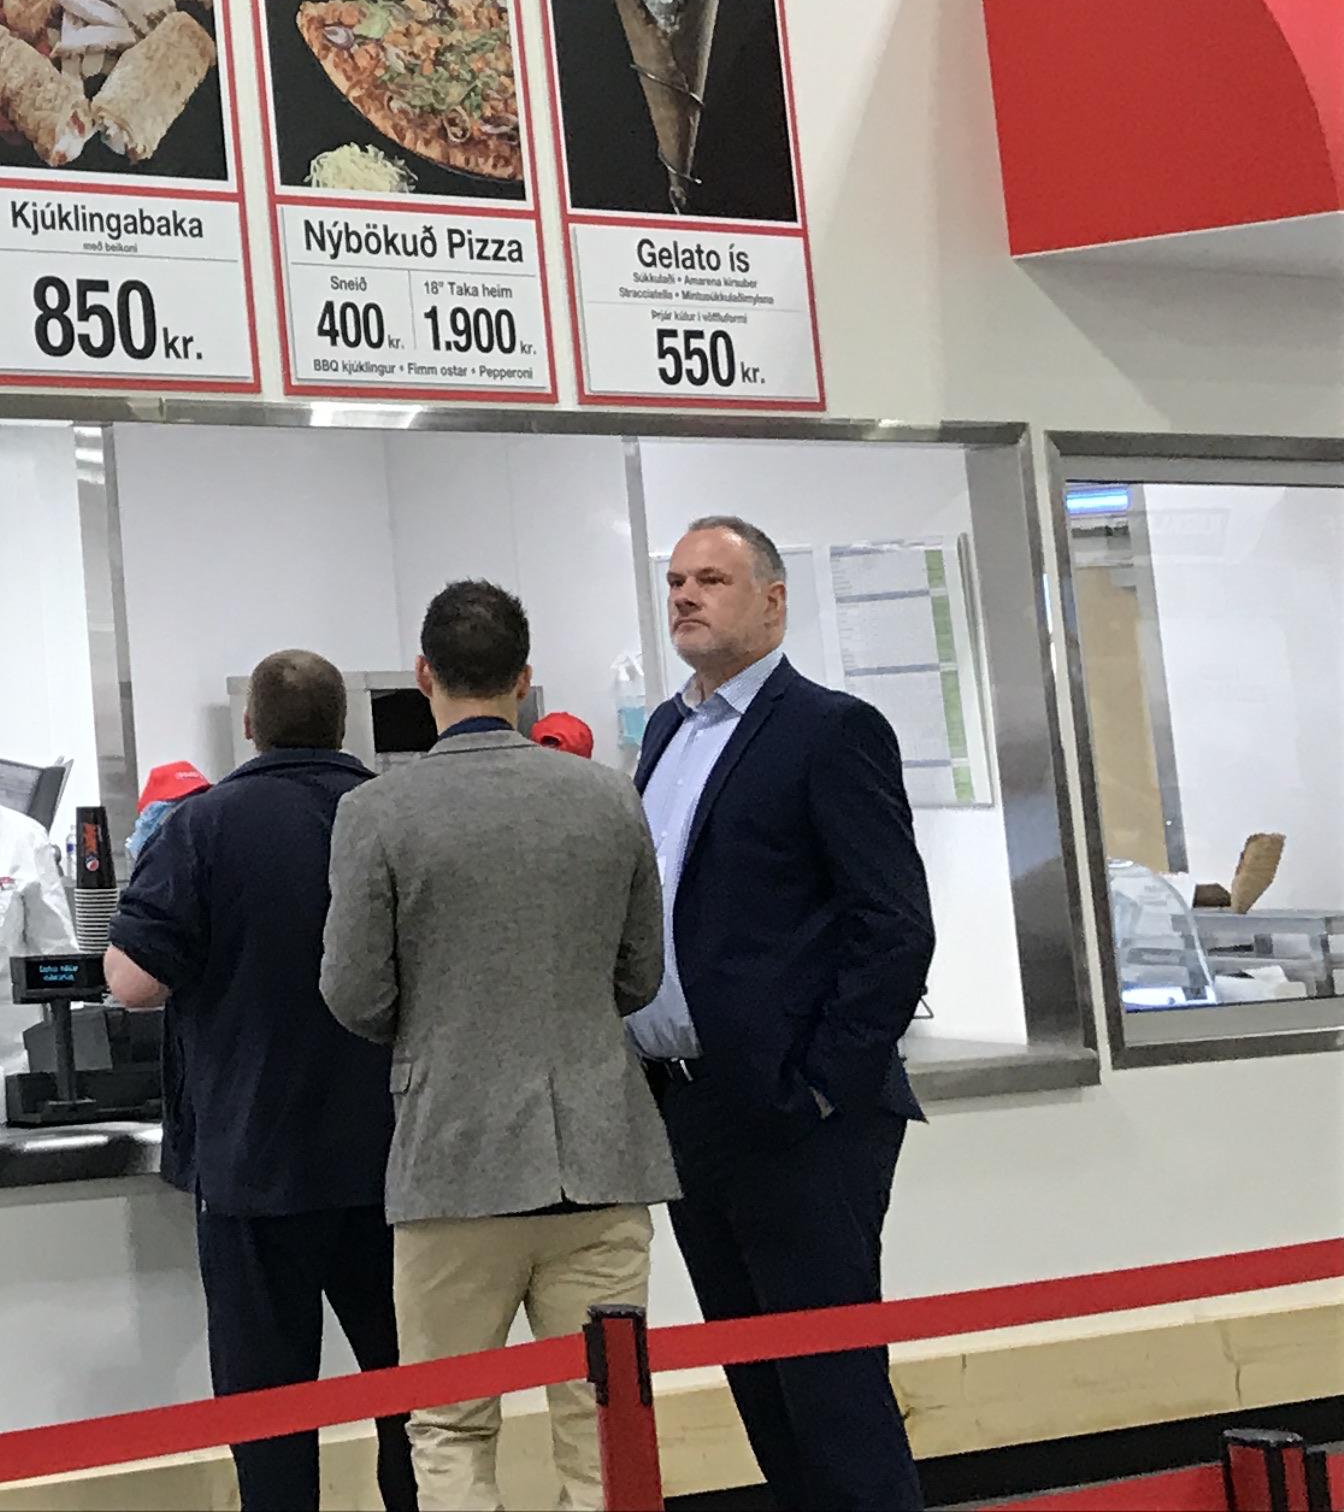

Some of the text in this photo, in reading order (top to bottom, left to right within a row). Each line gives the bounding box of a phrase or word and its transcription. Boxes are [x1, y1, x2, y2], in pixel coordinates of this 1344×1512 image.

[10, 199, 204, 239] Kjúklingabaka
[303, 219, 524, 263] Nýbökuð Pizza
[636, 238, 750, 273] Gelato ís
[330, 276, 367, 292] Sneið
[448, 281, 479, 297] Taka
[481, 284, 513, 299] heim
[33, 275, 203, 360] 850 kr.
[317, 300, 405, 350] 400 kr.
[424, 305, 537, 355] 1.900 kr.
[313, 358, 533, 380] BBQ kjúklingur Fimm ostar Pepperoni
[656, 328, 766, 387] 550 kr.
